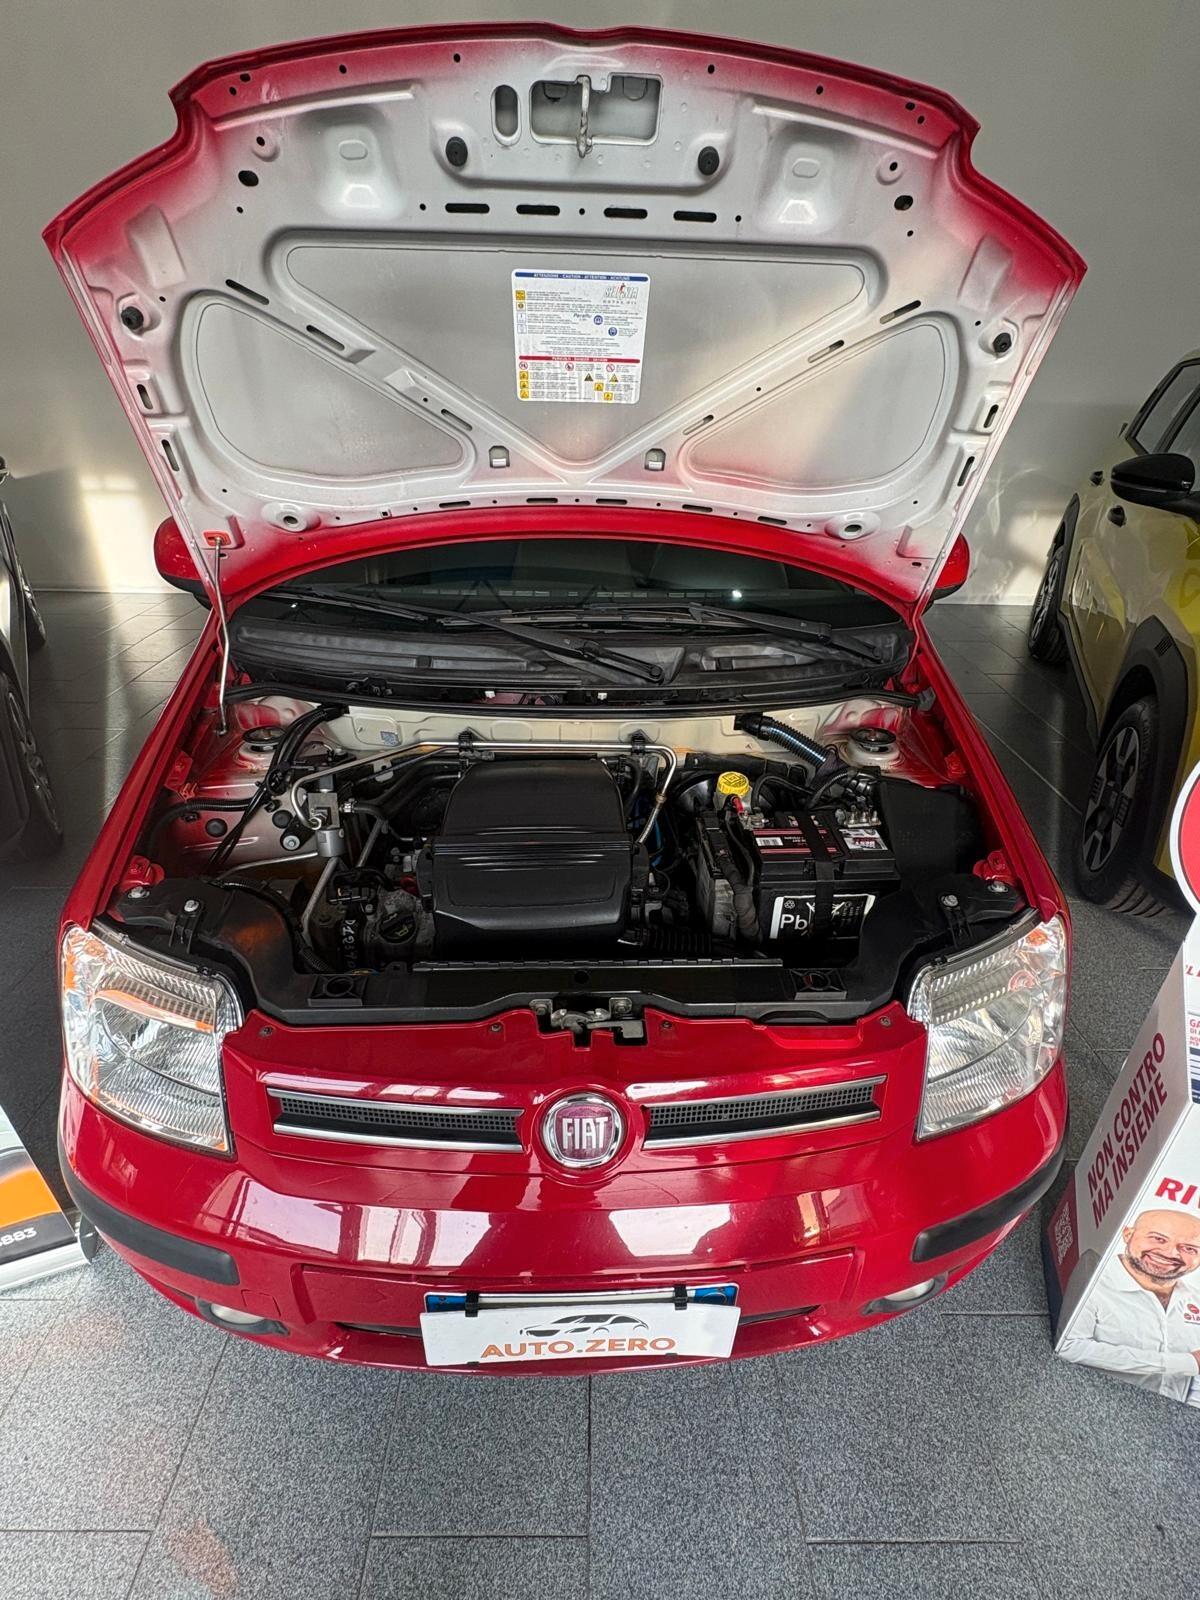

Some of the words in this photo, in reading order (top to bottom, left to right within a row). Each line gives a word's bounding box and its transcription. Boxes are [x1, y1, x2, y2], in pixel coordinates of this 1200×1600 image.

[780, 914, 808, 930] Pb
[1087, 1132, 1113, 1198] NON
[1114, 1032, 1165, 1144] CONTRO
[562, 1116, 609, 1150] FIAT
[1091, 1177, 1114, 1229] MA
[1112, 1072, 1168, 1190] INSIEME
[1155, 1177, 1200, 1209] RI
[0, 1227, 37, 1247] 883
[480, 1337, 676, 1358] AUTO.ZERO
